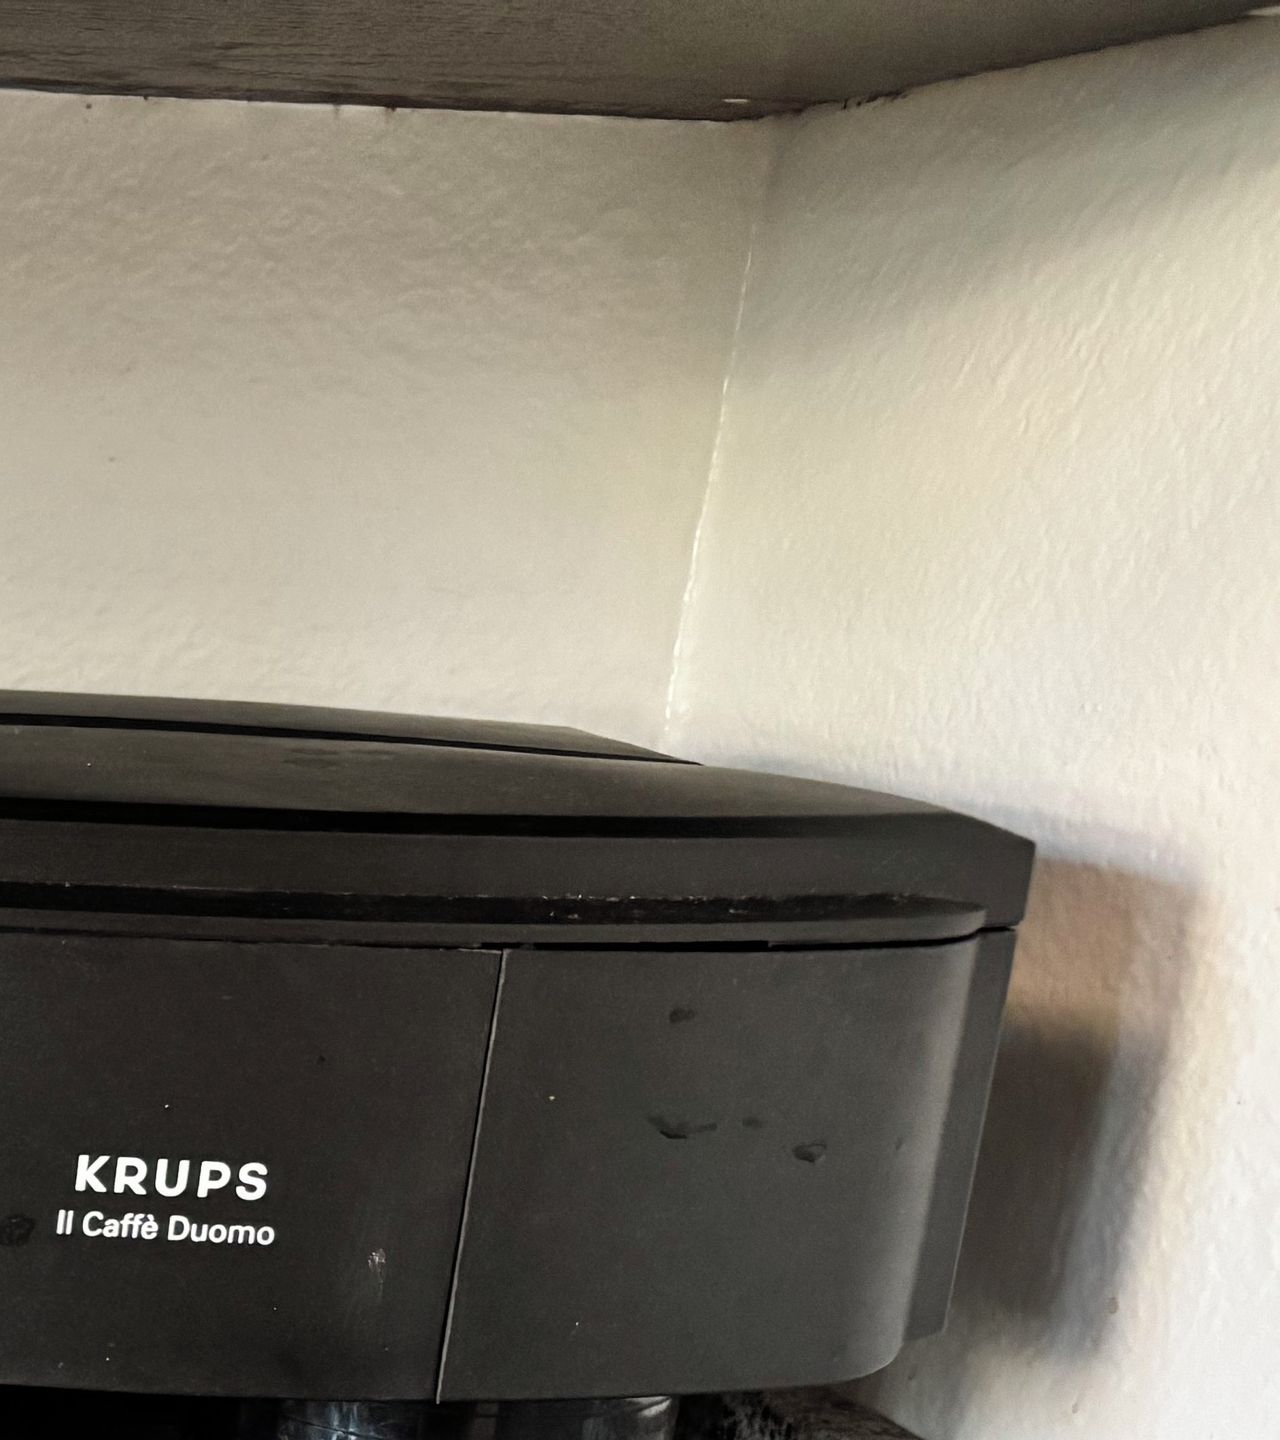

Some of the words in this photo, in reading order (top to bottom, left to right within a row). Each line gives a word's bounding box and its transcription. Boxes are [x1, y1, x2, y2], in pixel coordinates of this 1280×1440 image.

[74, 1154, 269, 1201] KRUPS
[56, 1209, 74, 1235] Il
[82, 1210, 159, 1240] Caffè
[167, 1214, 276, 1246] Duomo
